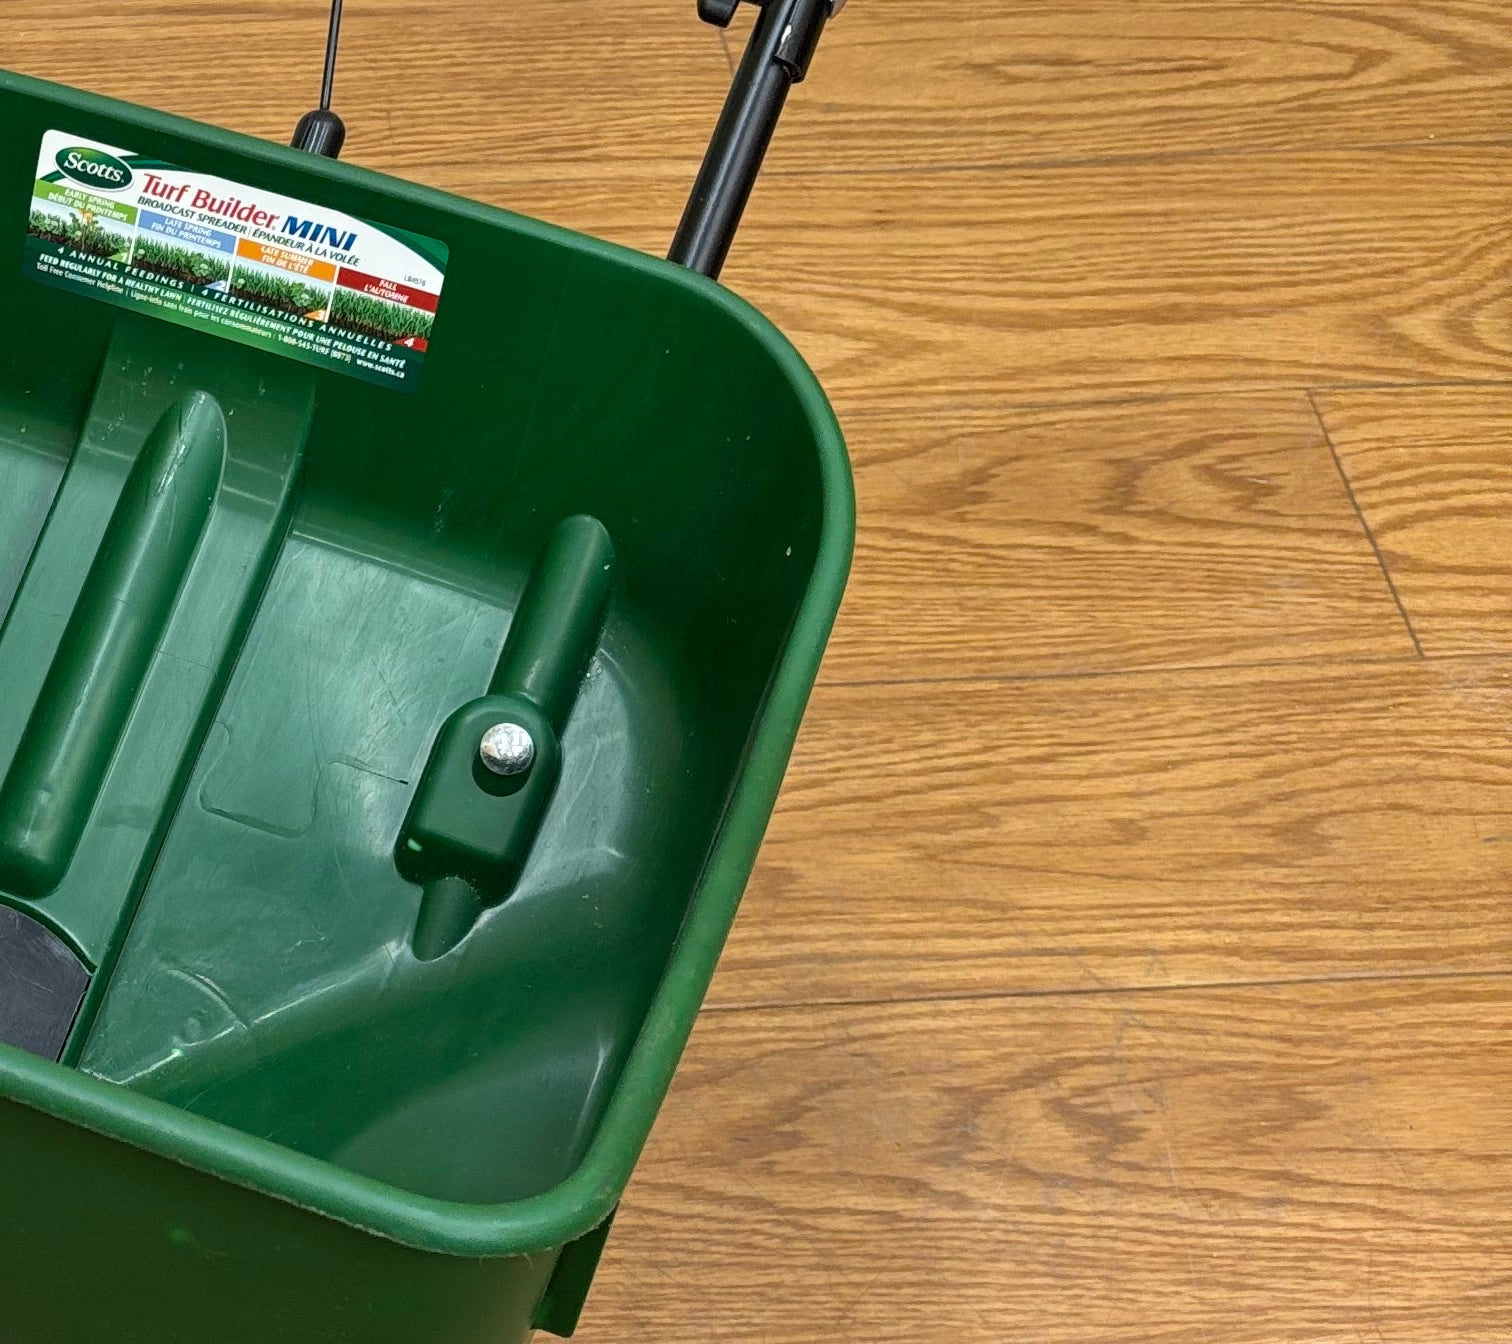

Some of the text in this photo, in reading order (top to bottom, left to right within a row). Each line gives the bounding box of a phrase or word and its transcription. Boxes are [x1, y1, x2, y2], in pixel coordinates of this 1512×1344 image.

[63, 150, 124, 183] Scotts
[48, 191, 128, 222] DÉBUT DU PRINTEMPS
[65, 189, 115, 209] EARLY SPRING
[142, 174, 358, 252] Turf Builder MINI
[137, 196, 196, 219] BROADCAST
[196, 213, 247, 234] SPREADER
[252, 227, 305, 251] ÉPANDEUR
[315, 247, 327, 257] LA
[330, 249, 360, 267] VOLÉE
[151, 222, 221, 249] FIN DU PRINTEMPS
[164, 218, 212, 237] LATE SPRING
[261, 245, 280, 257] LATE
[261, 254, 275, 264] FIN
[379, 279, 398, 291] FALL
[39, 253, 60, 266] FEED
[59, 259, 103, 278] REGULARLY
[101, 271, 117, 282] FOR
[124, 278, 160, 295] HEALTHY
[160, 288, 183, 302] LAWN
[292, 327, 315, 341] POUR
[315, 335, 333, 347] UNE
[332, 340, 367, 357] PELOUSE
[366, 350, 380, 361] EN
[379, 353, 406, 369] SANTÉ
[69, 249, 120, 271] ANNUAL
[124, 265, 185, 290] FEEDINGS
[213, 291, 315, 328] FERTILISATIONS
[318, 323, 393, 352] ANNUELLES
[403, 336, 416, 348] 4
